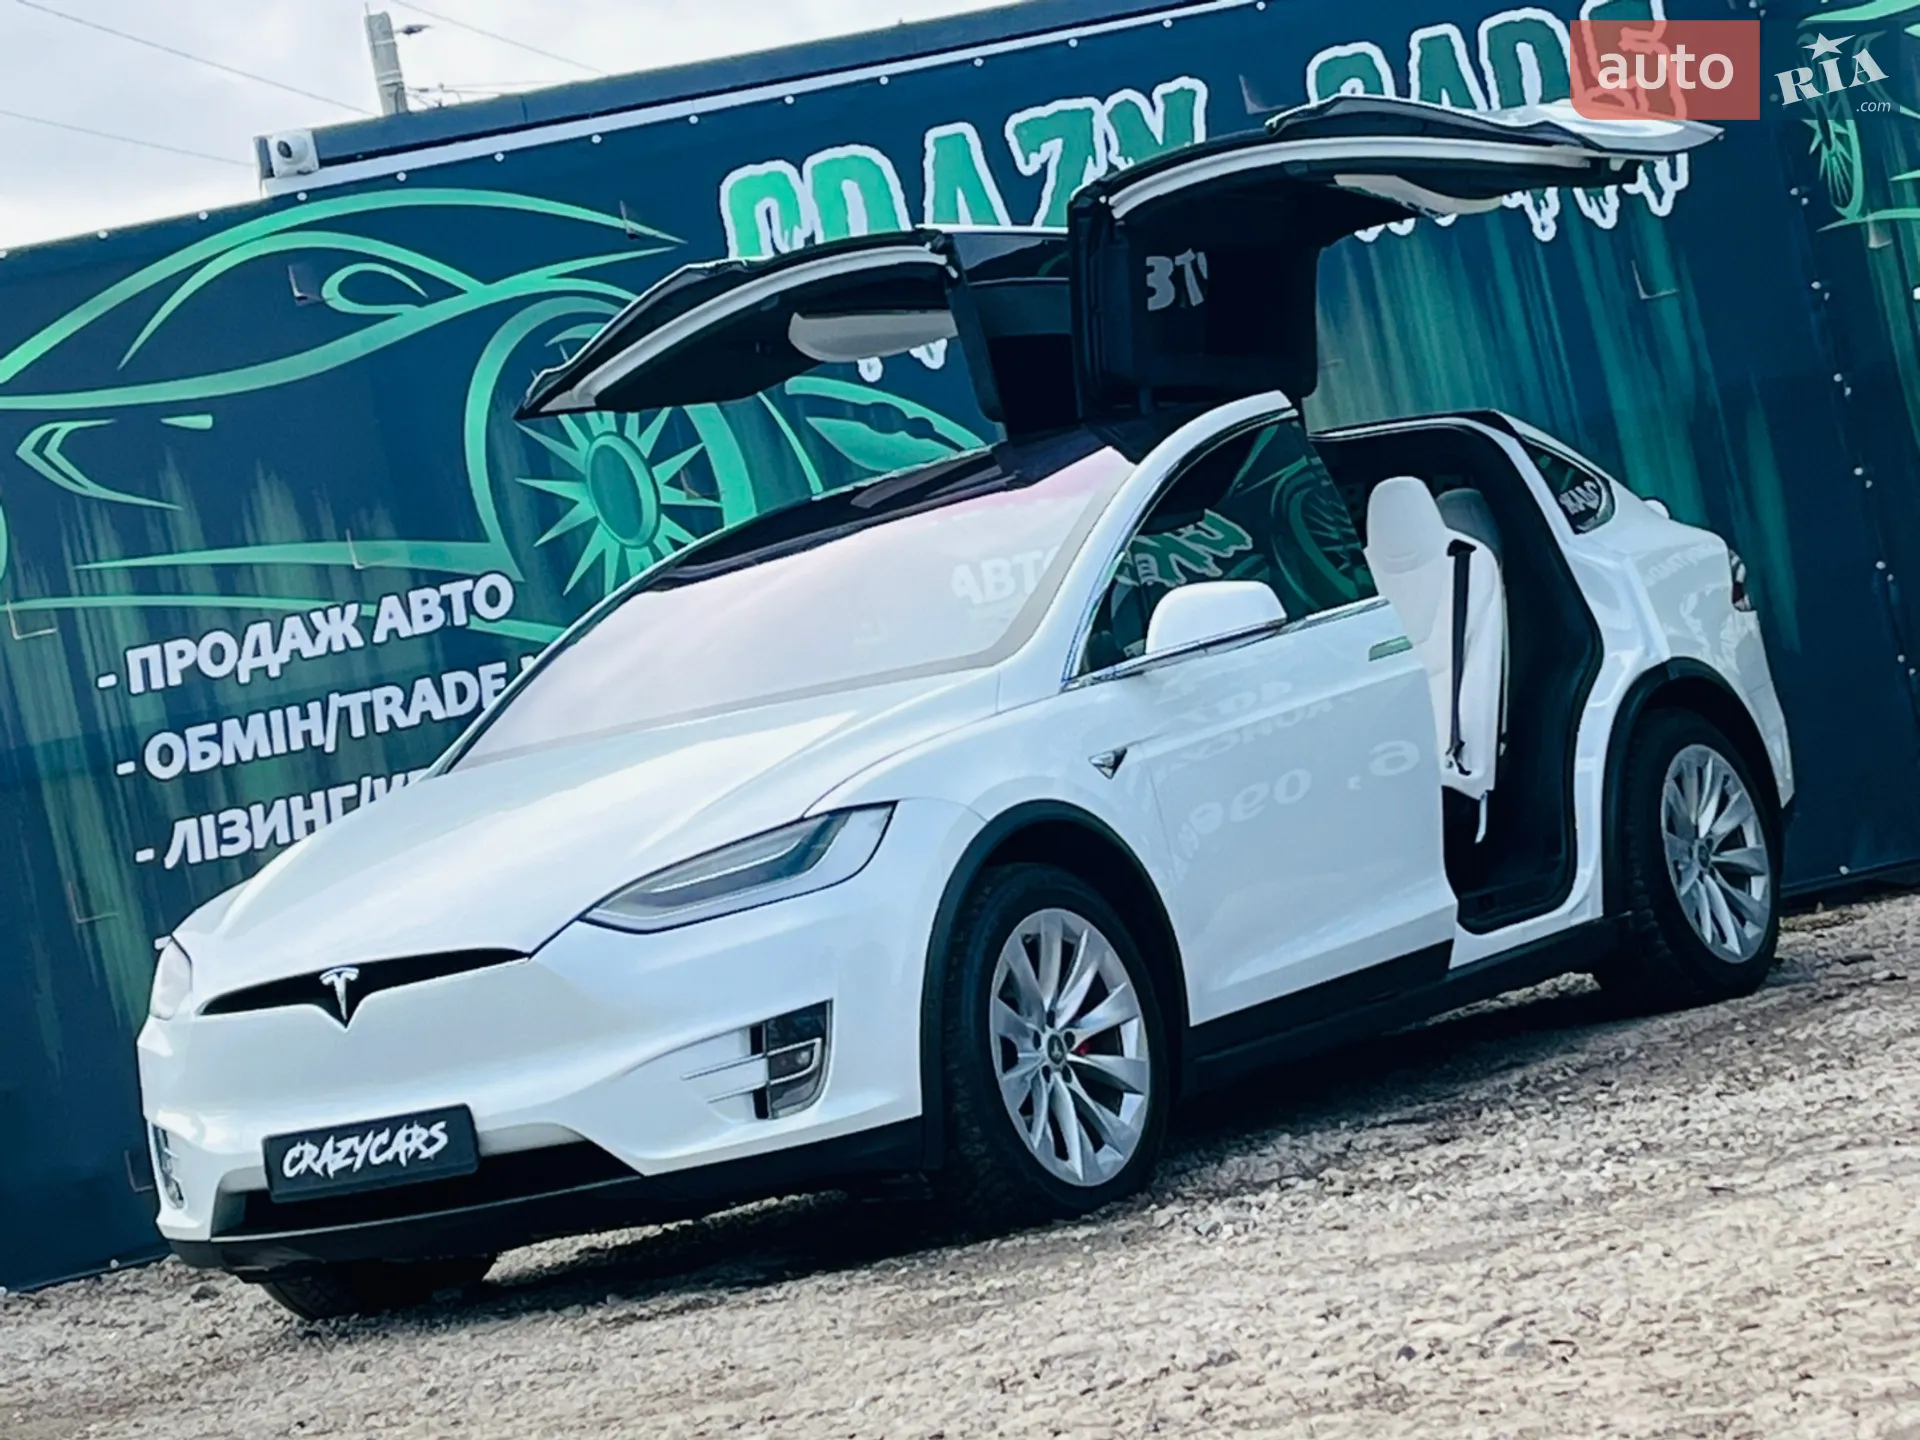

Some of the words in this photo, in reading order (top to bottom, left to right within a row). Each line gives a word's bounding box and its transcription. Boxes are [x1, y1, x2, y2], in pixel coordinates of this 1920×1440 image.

[950, 544, 1061, 605] АВТ
[125, 602, 363, 695] ПРОДАЖ
[371, 572, 515, 643] АВТО
[282, 1120, 449, 1179] CRAZYCARS
